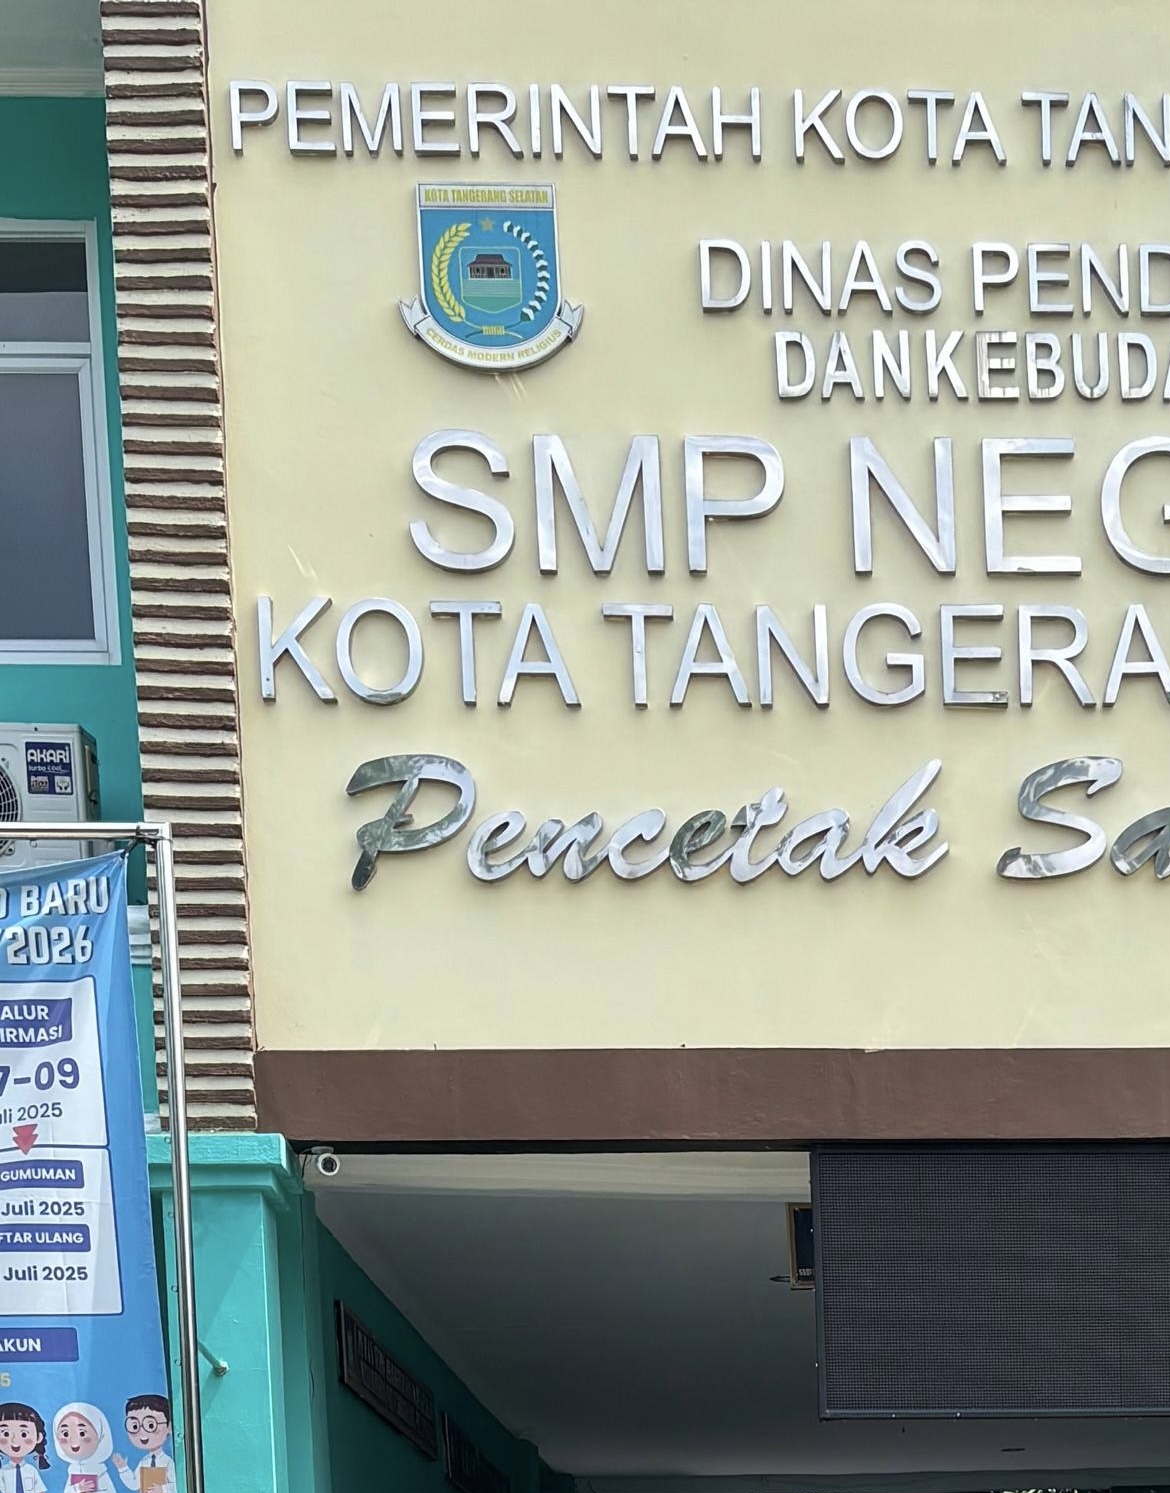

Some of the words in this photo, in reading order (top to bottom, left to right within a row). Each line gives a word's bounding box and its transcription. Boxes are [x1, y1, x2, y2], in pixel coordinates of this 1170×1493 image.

[229, 80, 763, 161] PEMERINTAH
[794, 89, 1008, 166] KOTA
[425, 189, 449, 203] KOTA
[451, 190, 505, 203] TANGERANG
[509, 190, 548, 204] SELATAN
[698, 238, 943, 315] DINAS
[426, 327, 464, 357] CERDAS
[467, 351, 514, 362] MODERN
[517, 329, 562, 360] RELIGIUS
[409, 428, 785, 577] SMP
[255, 595, 582, 710] KOTA
[346, 753, 950, 892] Pencetak
[20, 875, 110, 919] BARU
[17, 1102, 63, 1121] 2025
[0, 1168, 76, 1182] GUMUMAN
[1, 1200, 35, 1217] Juli
[38, 1201, 85, 1217] 2025
[35, 1232, 84, 1244] ULANG
[3, 1266, 38, 1281] Juli
[42, 1266, 89, 1281] 2025
